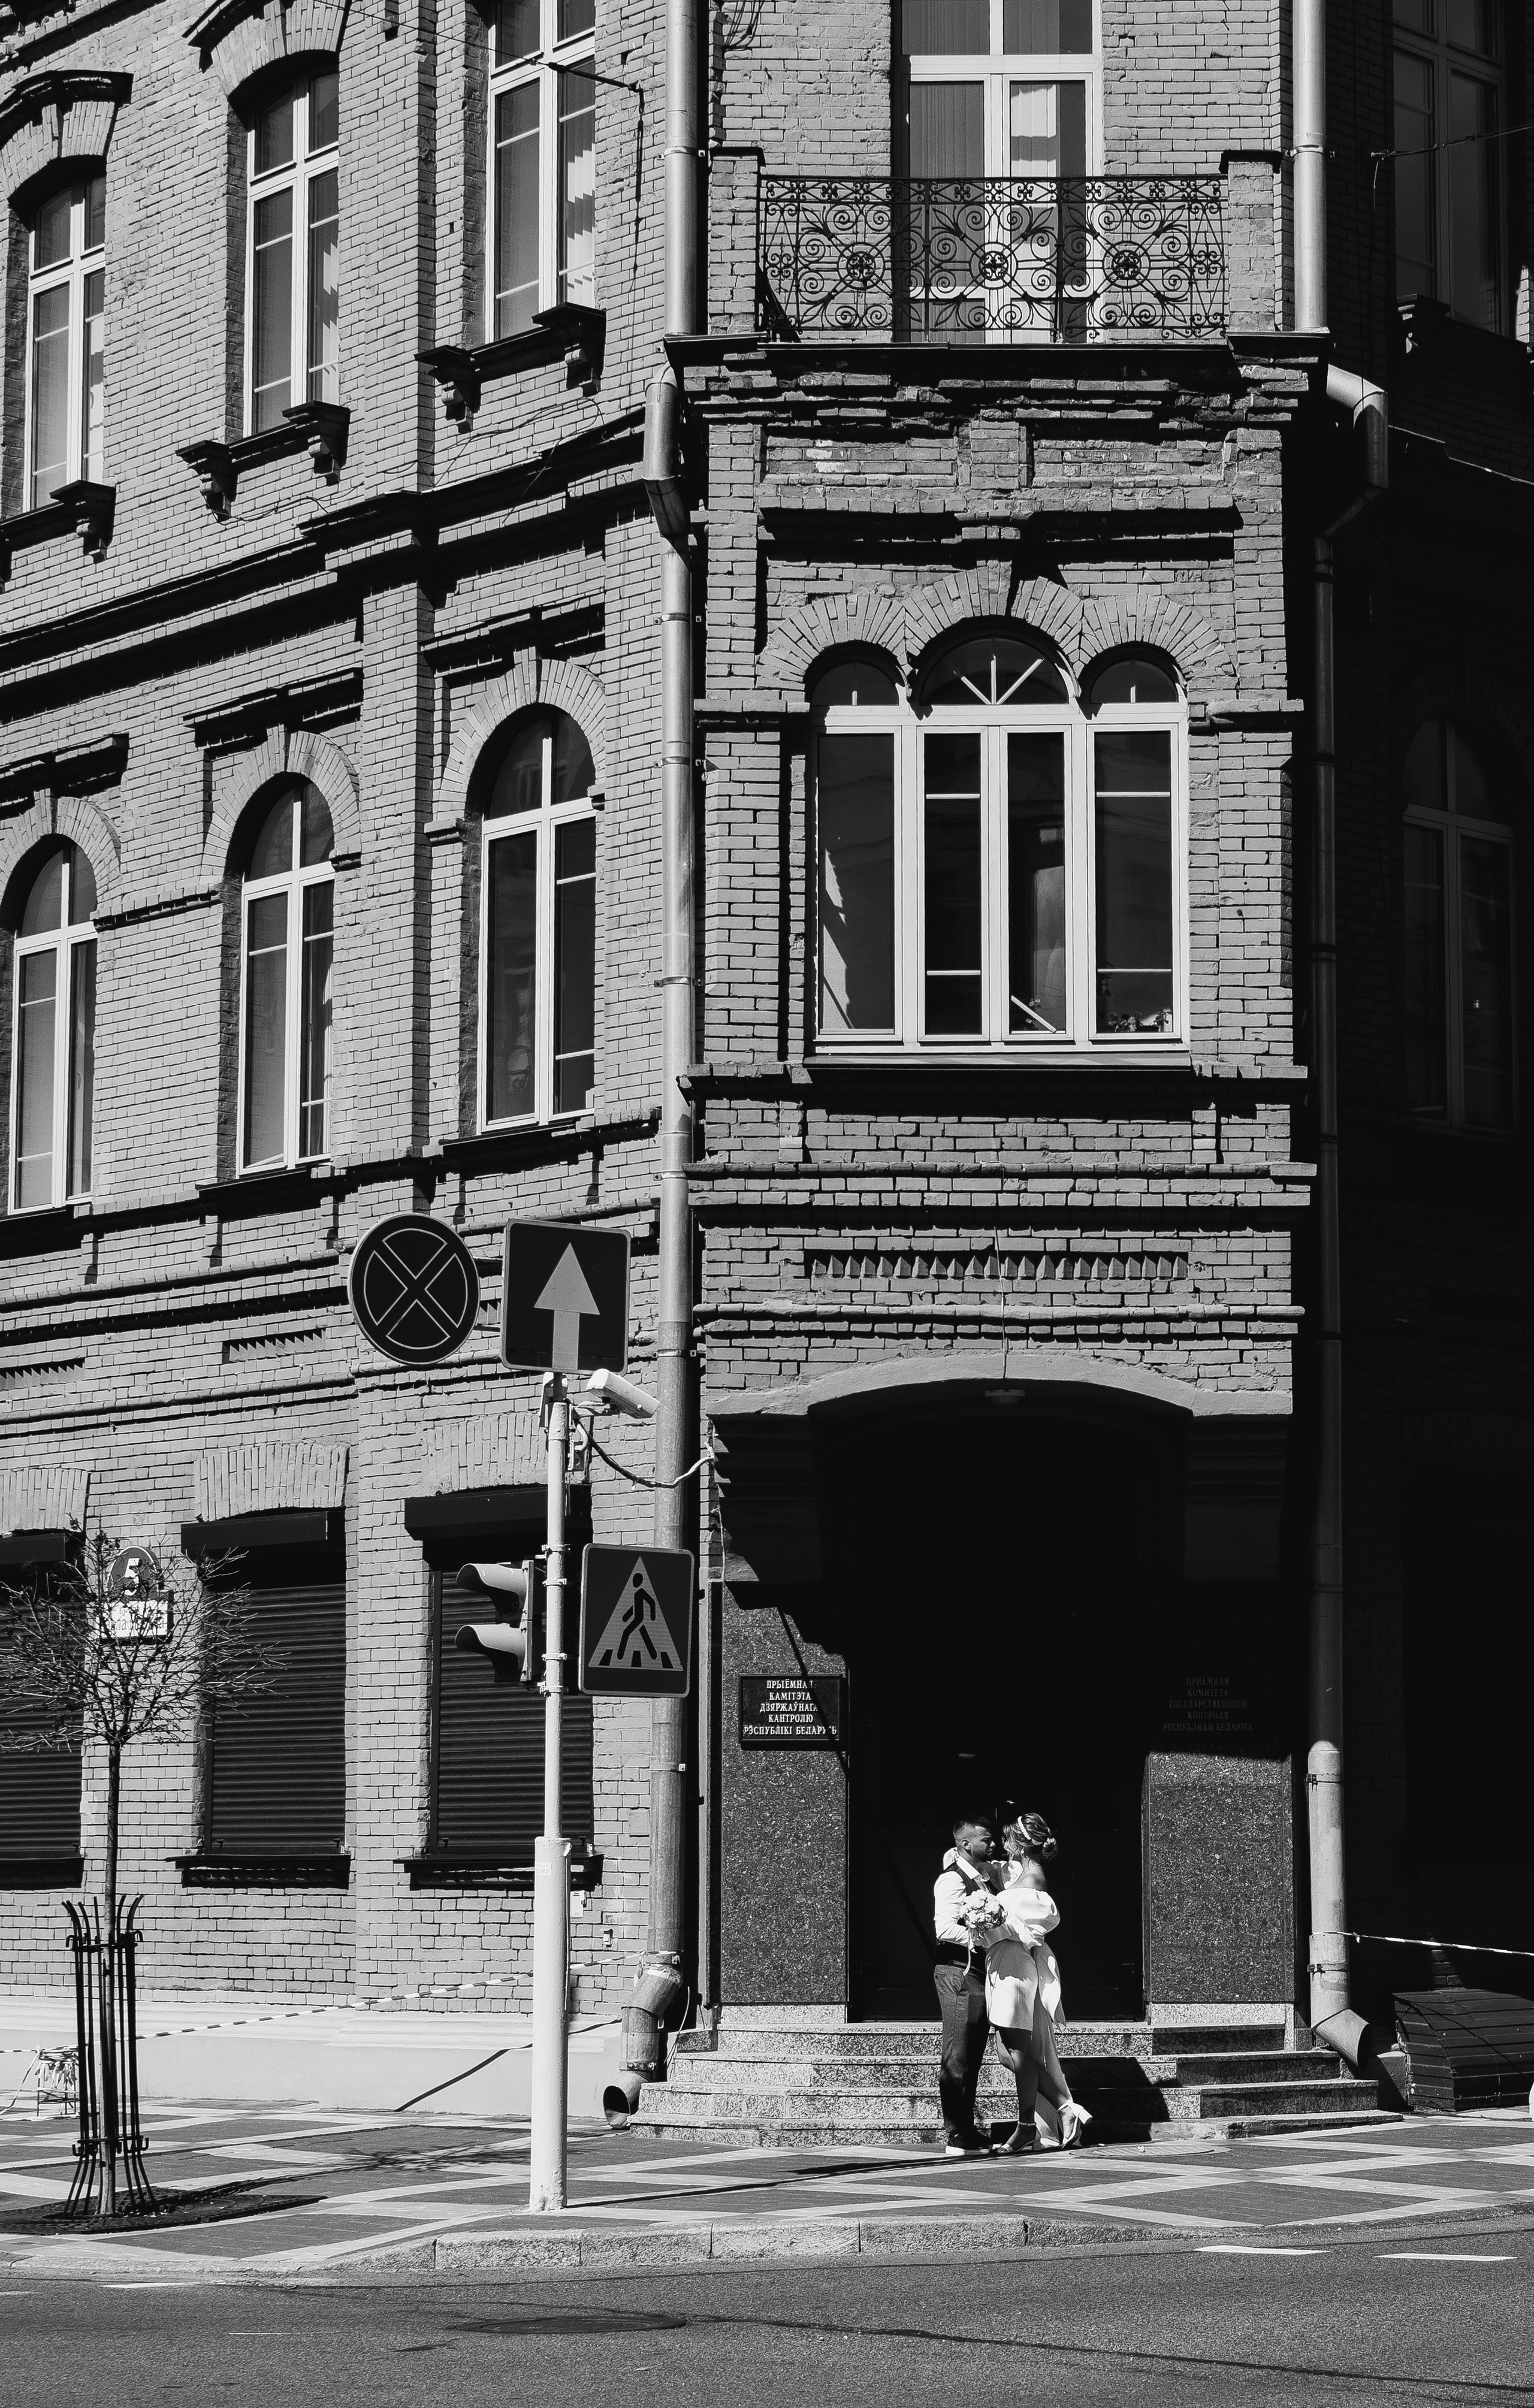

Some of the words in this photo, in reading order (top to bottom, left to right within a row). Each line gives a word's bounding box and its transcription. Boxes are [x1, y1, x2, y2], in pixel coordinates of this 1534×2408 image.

[1186, 1676, 1229, 1685] ПРИЁМНАЯ
[769, 1692, 811, 1700] КАМІТЭТА
[759, 1702, 818, 1713] ДЗЯРЖАЎНАГА
[1169, 1700, 1246, 1709] ГОСУДАРСТВЕННОГО
[768, 1714, 814, 1723] КАНТРОЛЮ
[1188, 1711, 1229, 1720] КОНТРОЛЯ
[743, 1724, 793, 1735] РЭСПУБЛІКІ
[1163, 1723, 1213, 1732] РЕСПУБЛИКИ
[1216, 1723, 1254, 1732] БЕЛАРУСЬ
